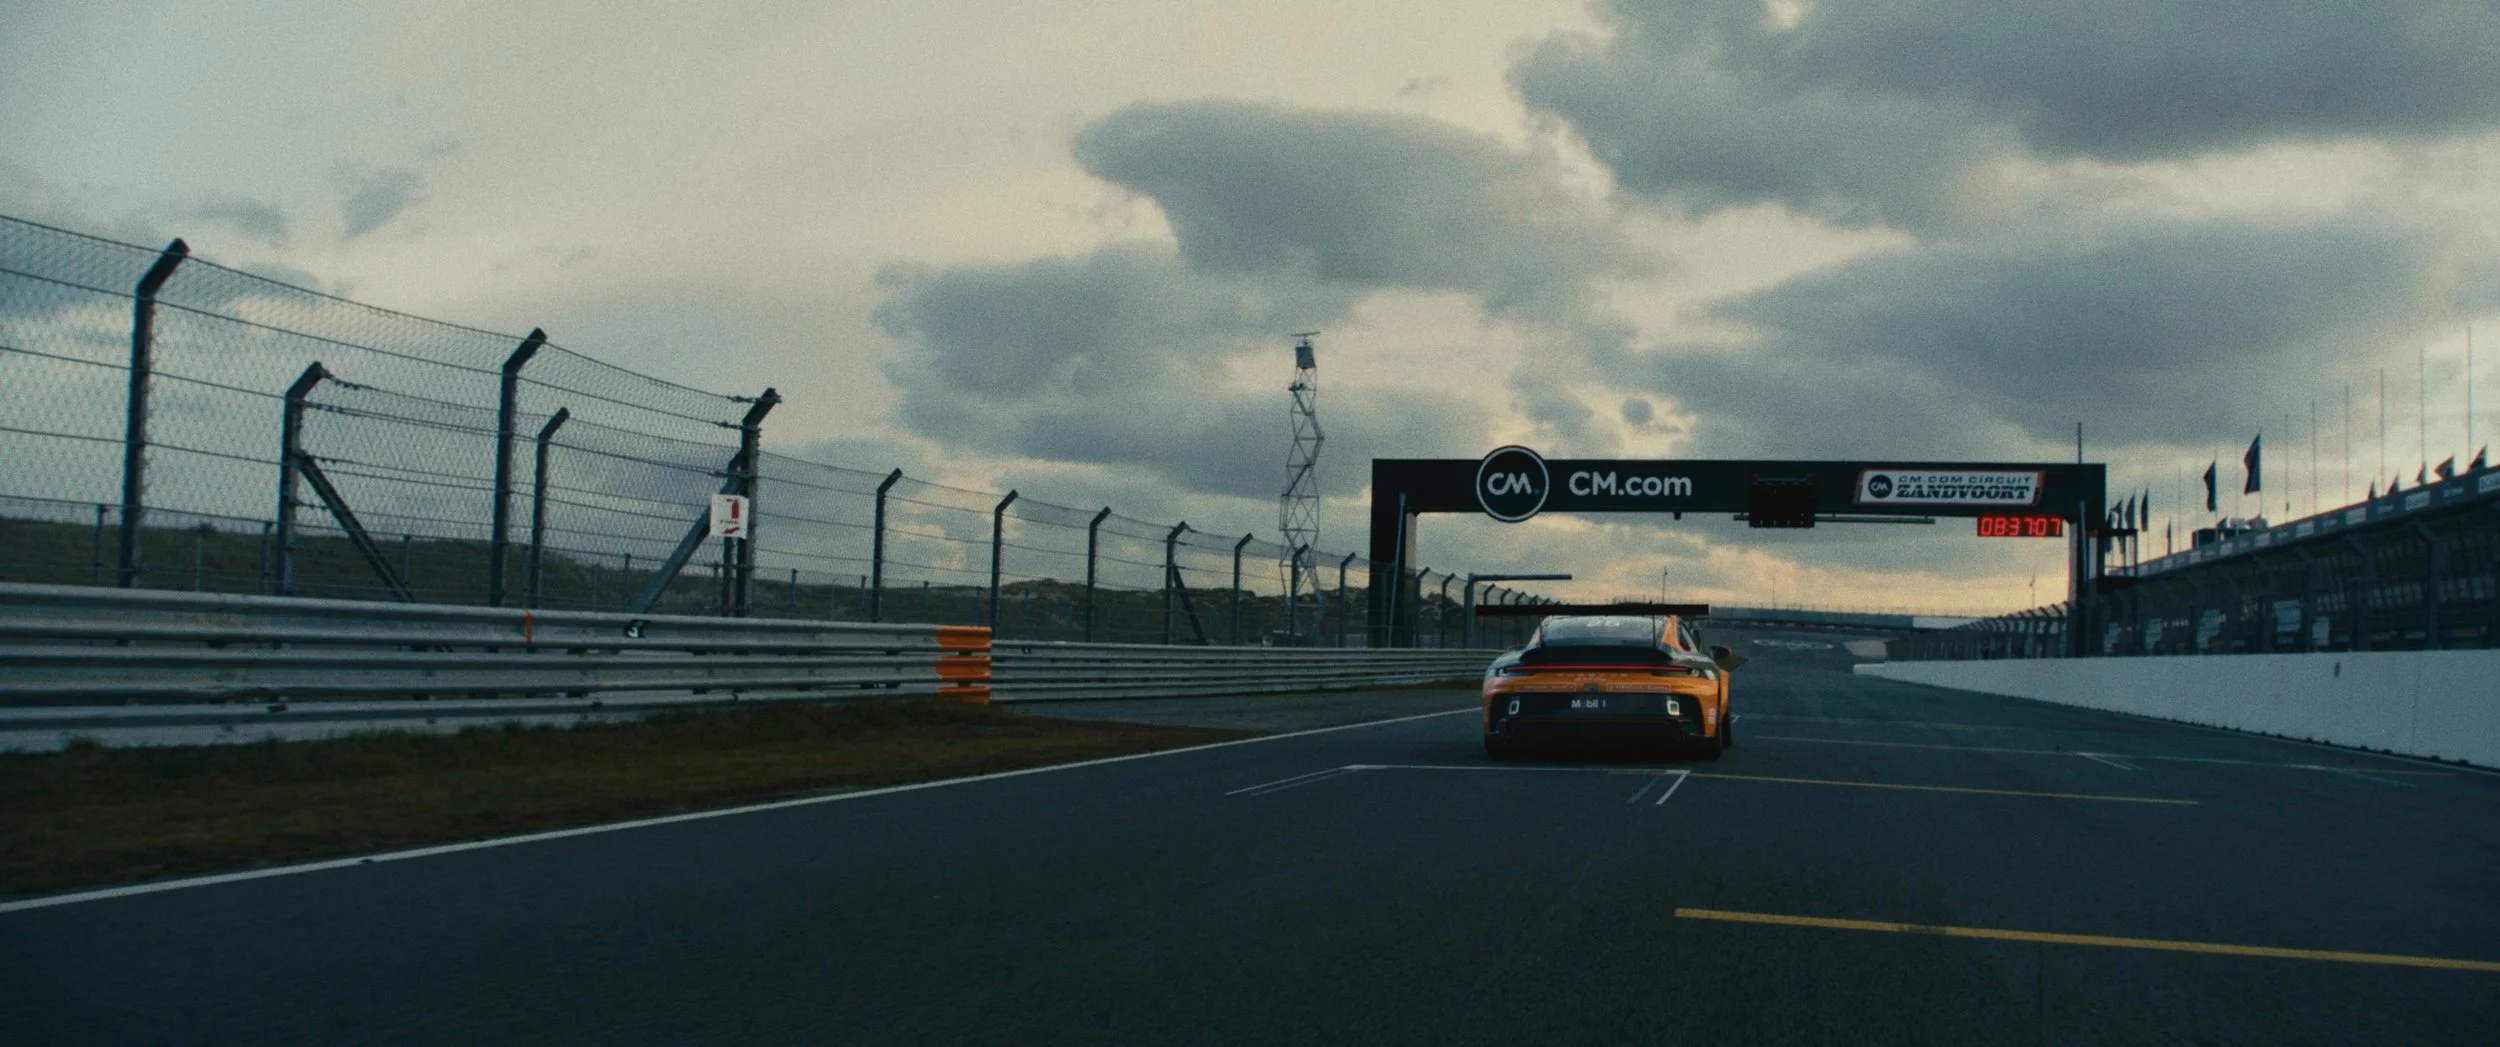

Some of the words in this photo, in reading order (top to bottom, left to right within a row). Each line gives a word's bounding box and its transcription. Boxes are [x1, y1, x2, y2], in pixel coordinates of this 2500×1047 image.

[1568, 471, 1692, 497] CM.com
[1968, 475, 2032, 485] CIRCUIT
[1896, 484, 2031, 500] ZANDVOORT
[1981, 516, 2061, 536] 08:37:07
[1571, 699, 1599, 709] Mbil
